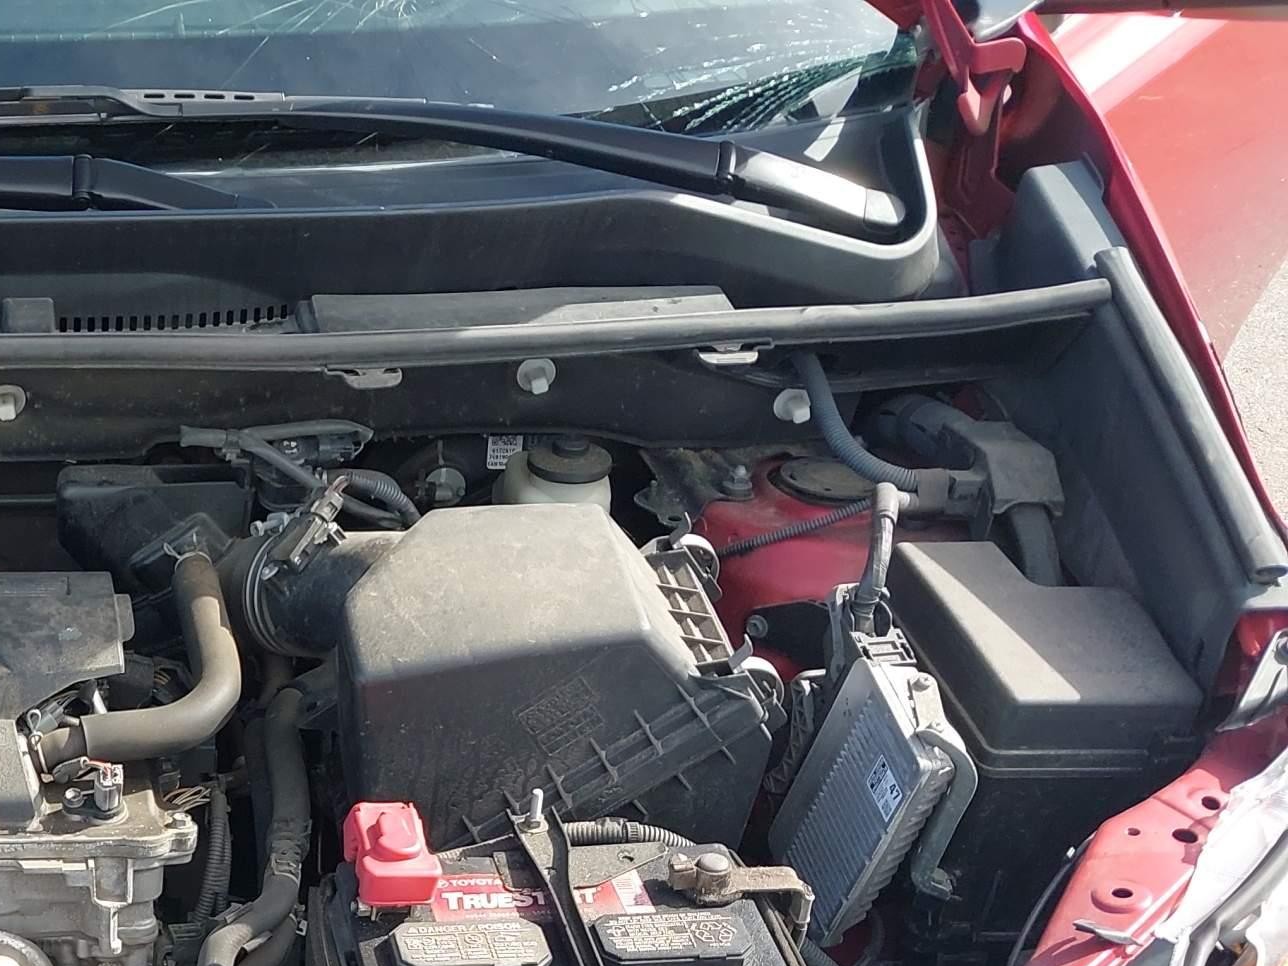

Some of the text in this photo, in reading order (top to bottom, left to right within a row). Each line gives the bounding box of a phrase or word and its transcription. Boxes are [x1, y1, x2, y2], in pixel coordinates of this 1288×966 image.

[452, 878, 502, 888] TOYOTA
[418, 925, 467, 934] DANGER
[478, 922, 521, 932] POISON
